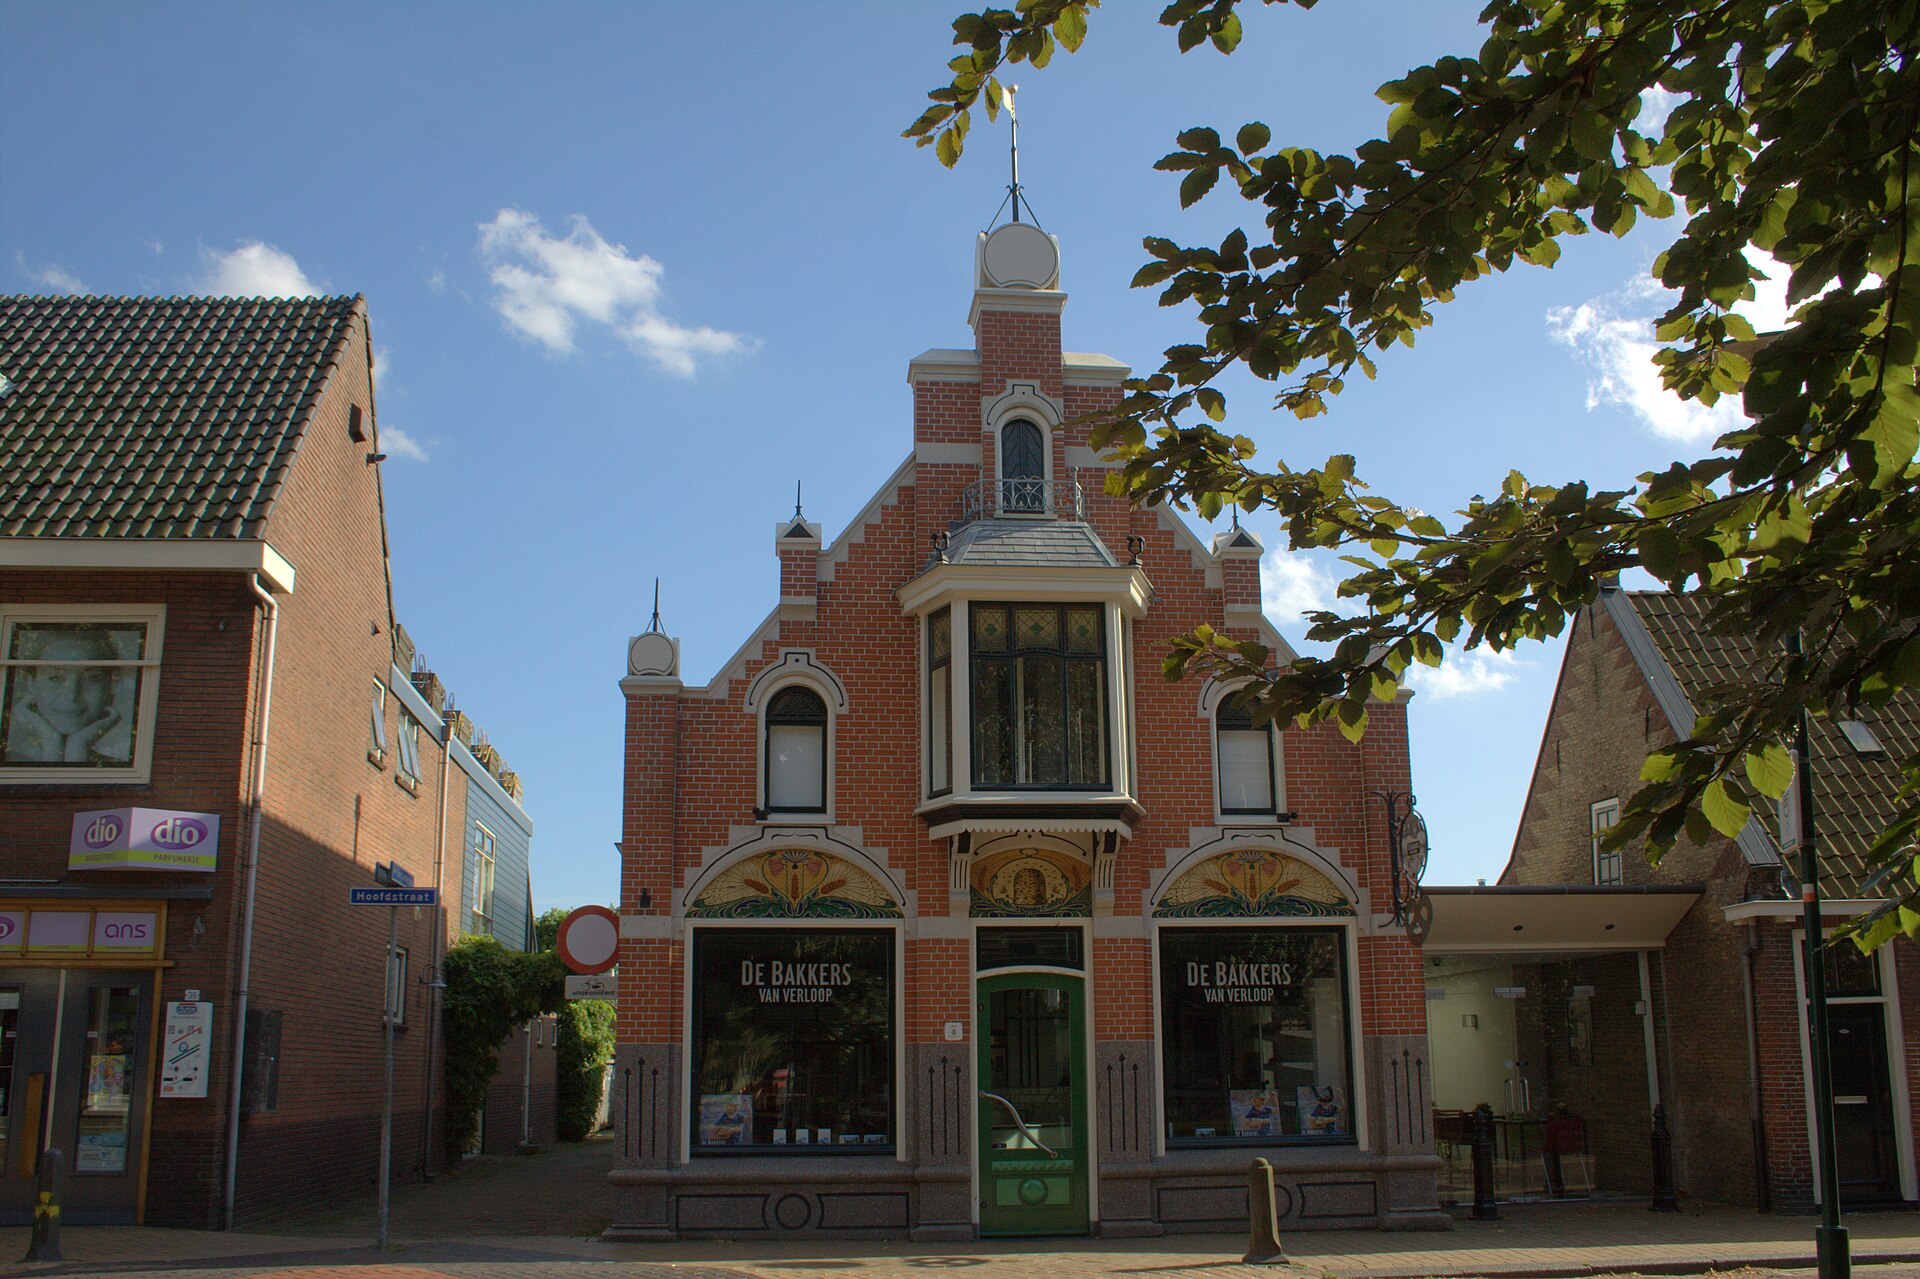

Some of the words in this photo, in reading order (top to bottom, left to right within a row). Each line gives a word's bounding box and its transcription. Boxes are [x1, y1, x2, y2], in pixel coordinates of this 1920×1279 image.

[87, 818, 117, 843] dio
[154, 818, 200, 845] dio
[153, 853, 201, 864] PARFUMERIE
[356, 891, 430, 901] Hoofdstraat
[105, 923, 147, 938] ans
[741, 960, 765, 986] DE
[771, 960, 852, 986] BAKKERS
[1187, 961, 1210, 987] DE
[1215, 961, 1292, 986] BAKKERS
[759, 988, 780, 1003] VAN
[782, 988, 833, 1003] VERLOOP
[1204, 988, 1225, 1003] VAN
[1226, 987, 1274, 1002] VERLOOP
